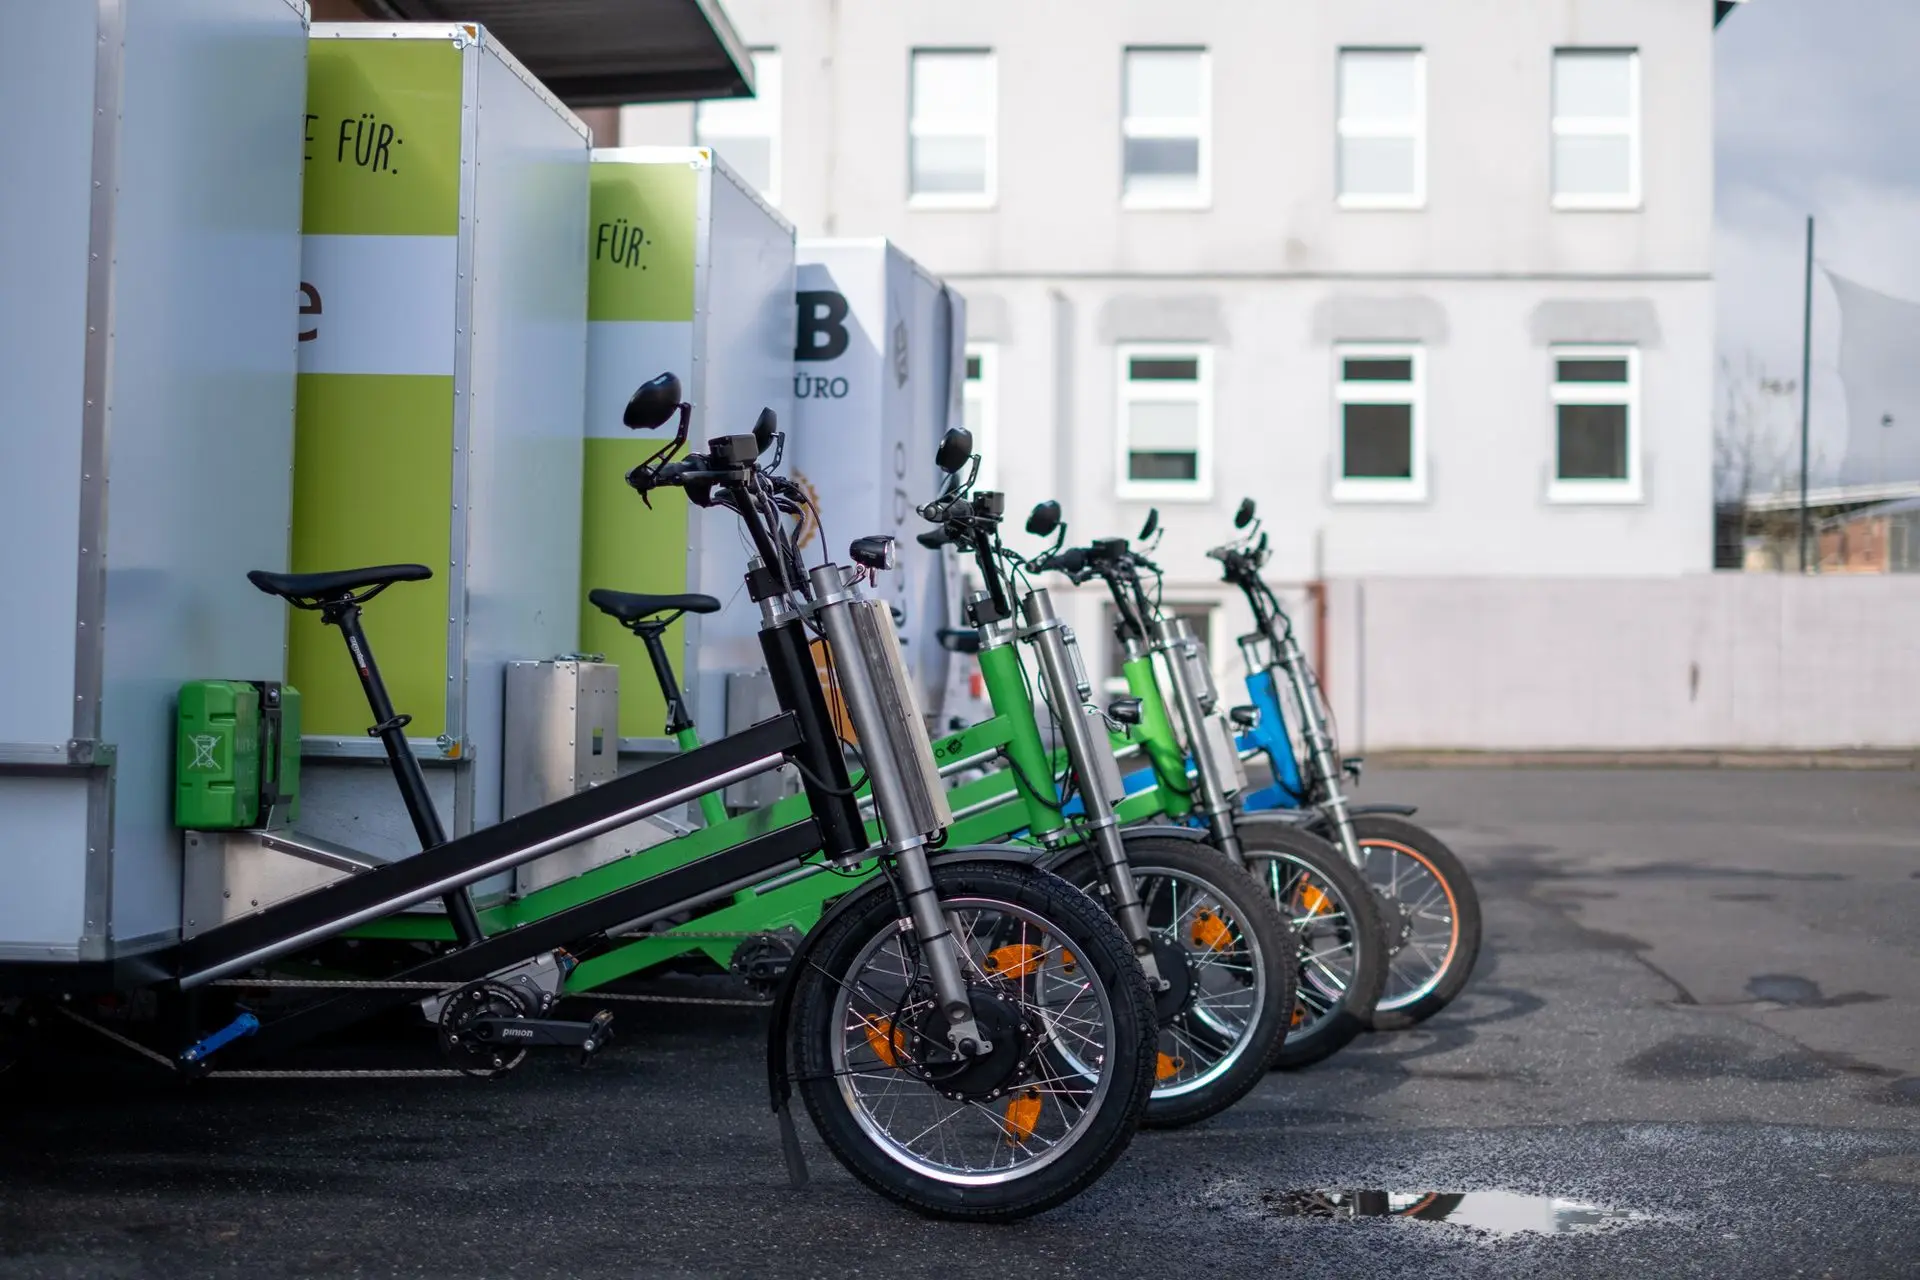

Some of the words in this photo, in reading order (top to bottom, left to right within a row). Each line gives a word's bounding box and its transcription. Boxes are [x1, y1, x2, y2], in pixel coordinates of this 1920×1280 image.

[337, 112, 403, 175] FÜR:
[596, 218, 652, 271] FÜR:
[794, 289, 850, 362] B
[793, 371, 849, 399] ÜRO
[502, 1028, 534, 1038] pinion
